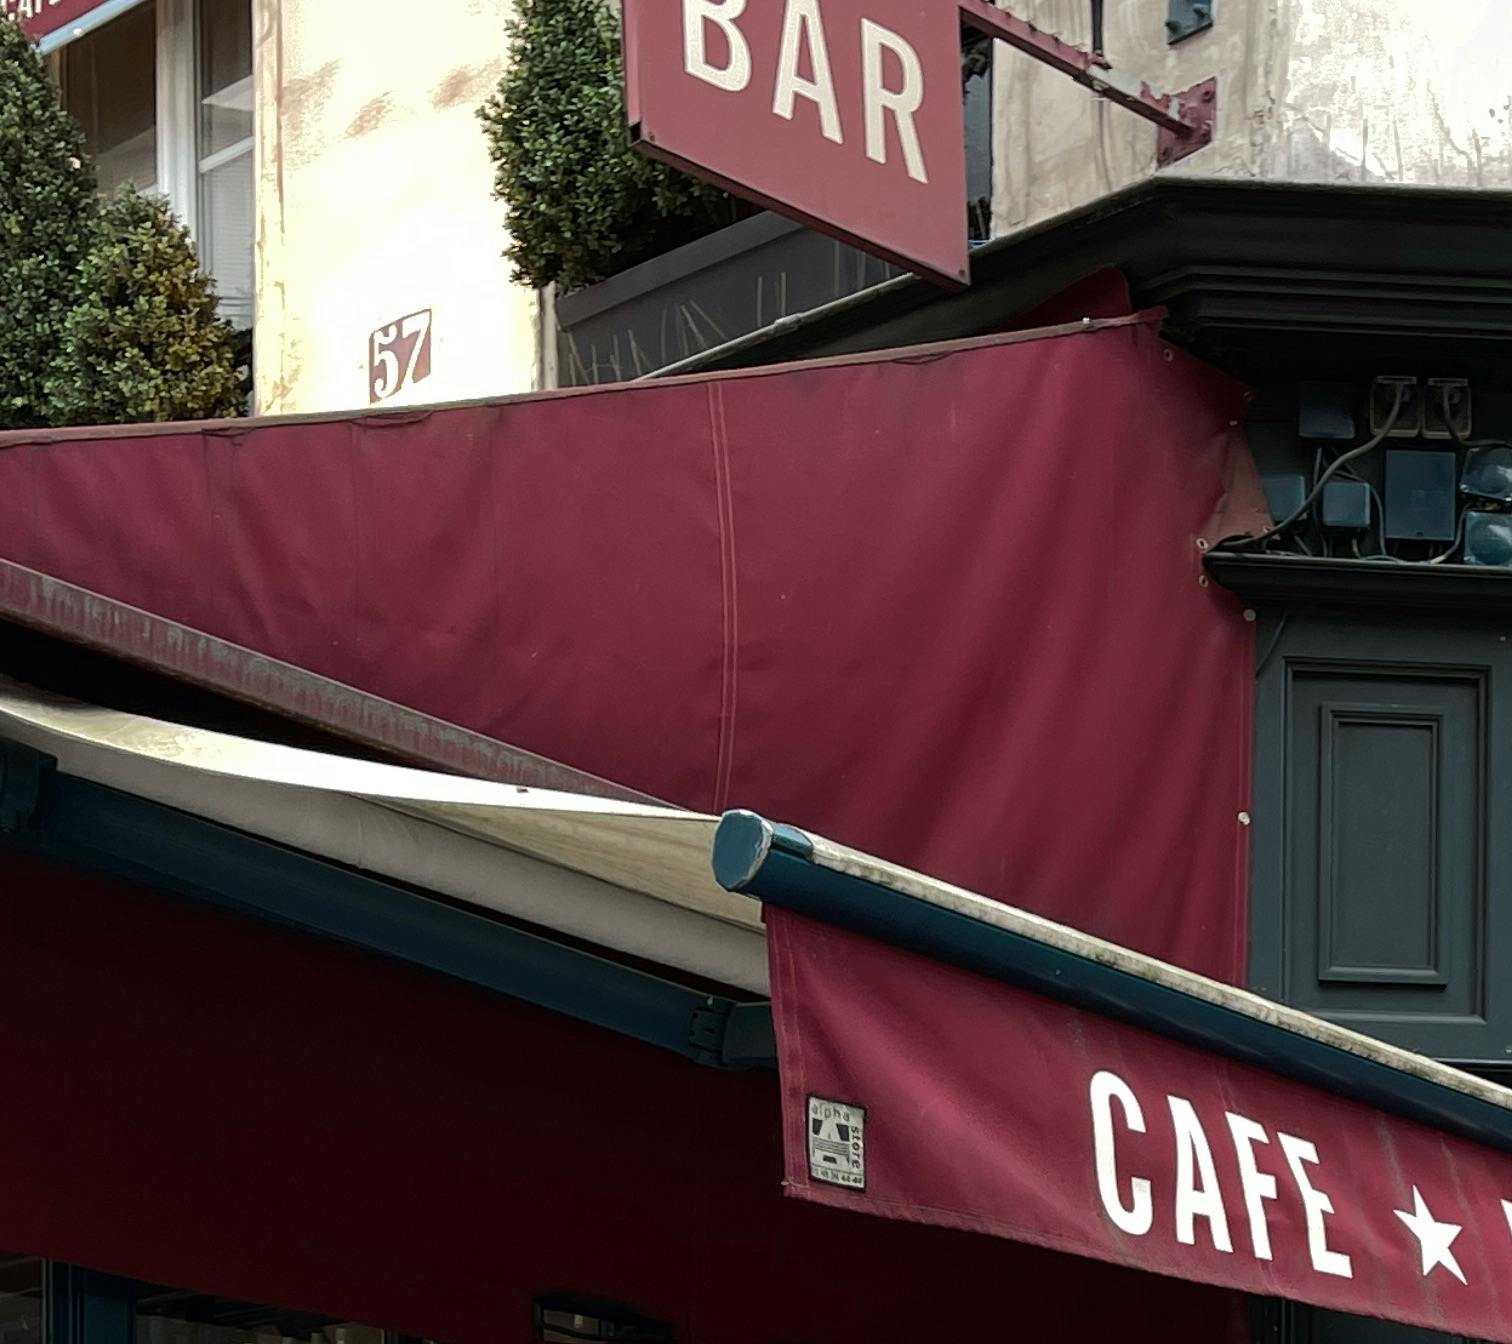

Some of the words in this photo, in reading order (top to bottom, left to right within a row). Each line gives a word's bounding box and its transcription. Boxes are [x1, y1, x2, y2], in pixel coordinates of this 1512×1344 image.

[683, 0, 929, 184] BAR
[373, 311, 430, 399] 57
[812, 1103, 850, 1121] alpha
[851, 1126, 861, 1169] store
[1089, 1070, 1353, 1279] CAFE
